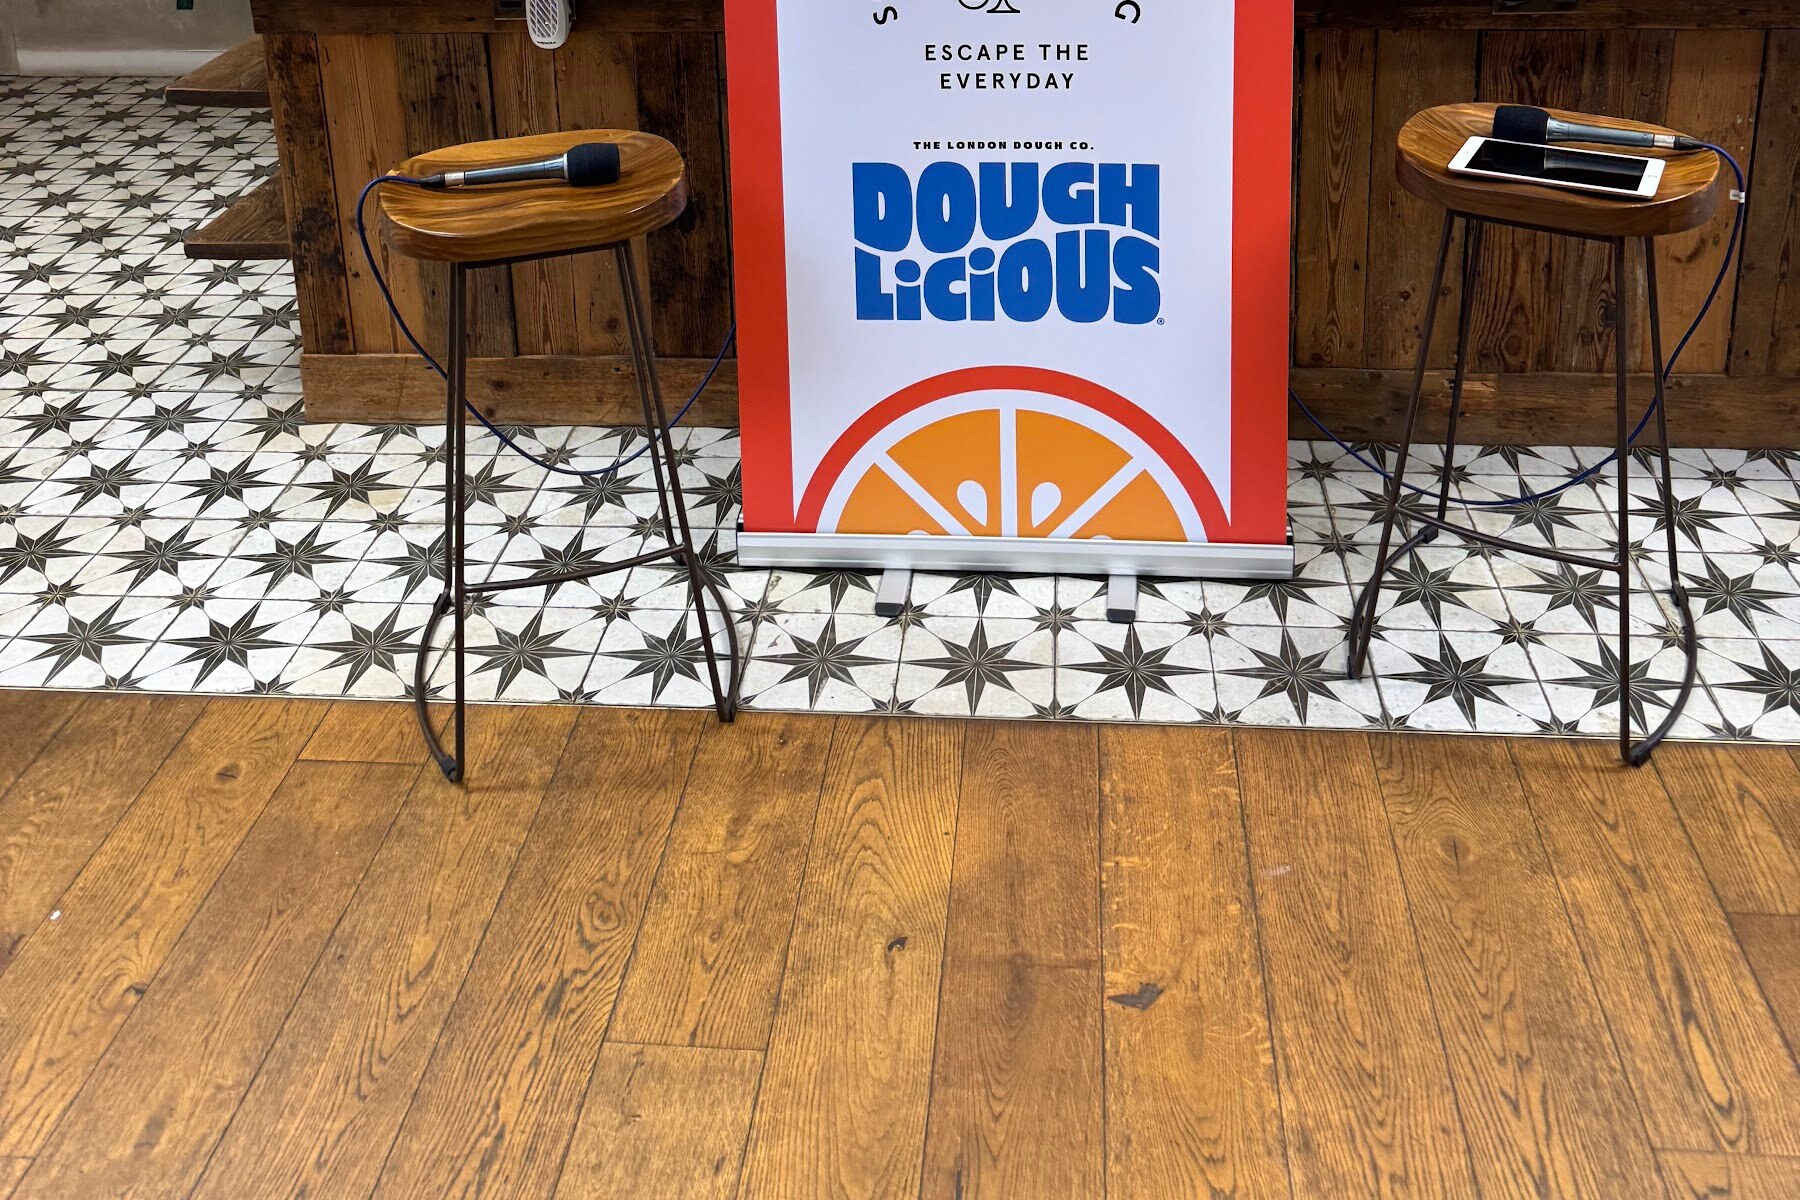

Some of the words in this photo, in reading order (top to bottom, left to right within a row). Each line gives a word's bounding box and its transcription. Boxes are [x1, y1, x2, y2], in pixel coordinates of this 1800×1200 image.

[925, 44, 1025, 61] ESCAPE
[1038, 43, 1089, 61] THE
[940, 72, 1074, 90] EVERYDAY
[912, 141, 941, 150] THE
[947, 141, 1007, 150] LONDON
[1013, 141, 1063, 150] DOUGH
[1069, 141, 1095, 150] CO.
[851, 160, 1160, 256] DOUGH
